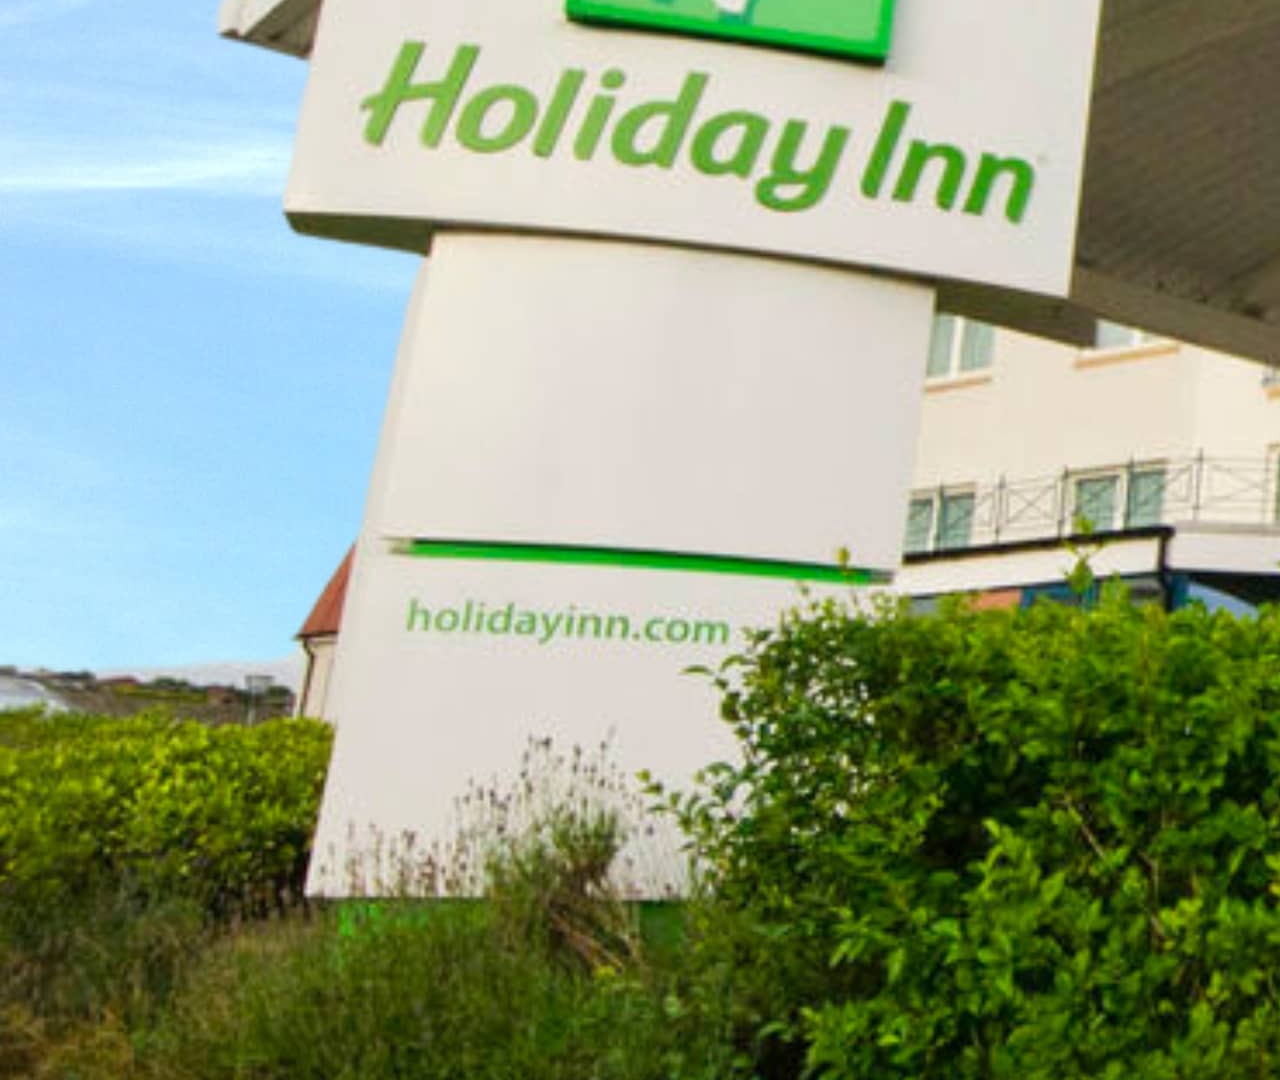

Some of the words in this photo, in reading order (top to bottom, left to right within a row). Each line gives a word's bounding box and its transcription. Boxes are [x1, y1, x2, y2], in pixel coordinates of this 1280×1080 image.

[359, 41, 850, 213] Holiday
[860, 100, 1036, 224] Inn
[406, 598, 729, 644] holidayinn.com
